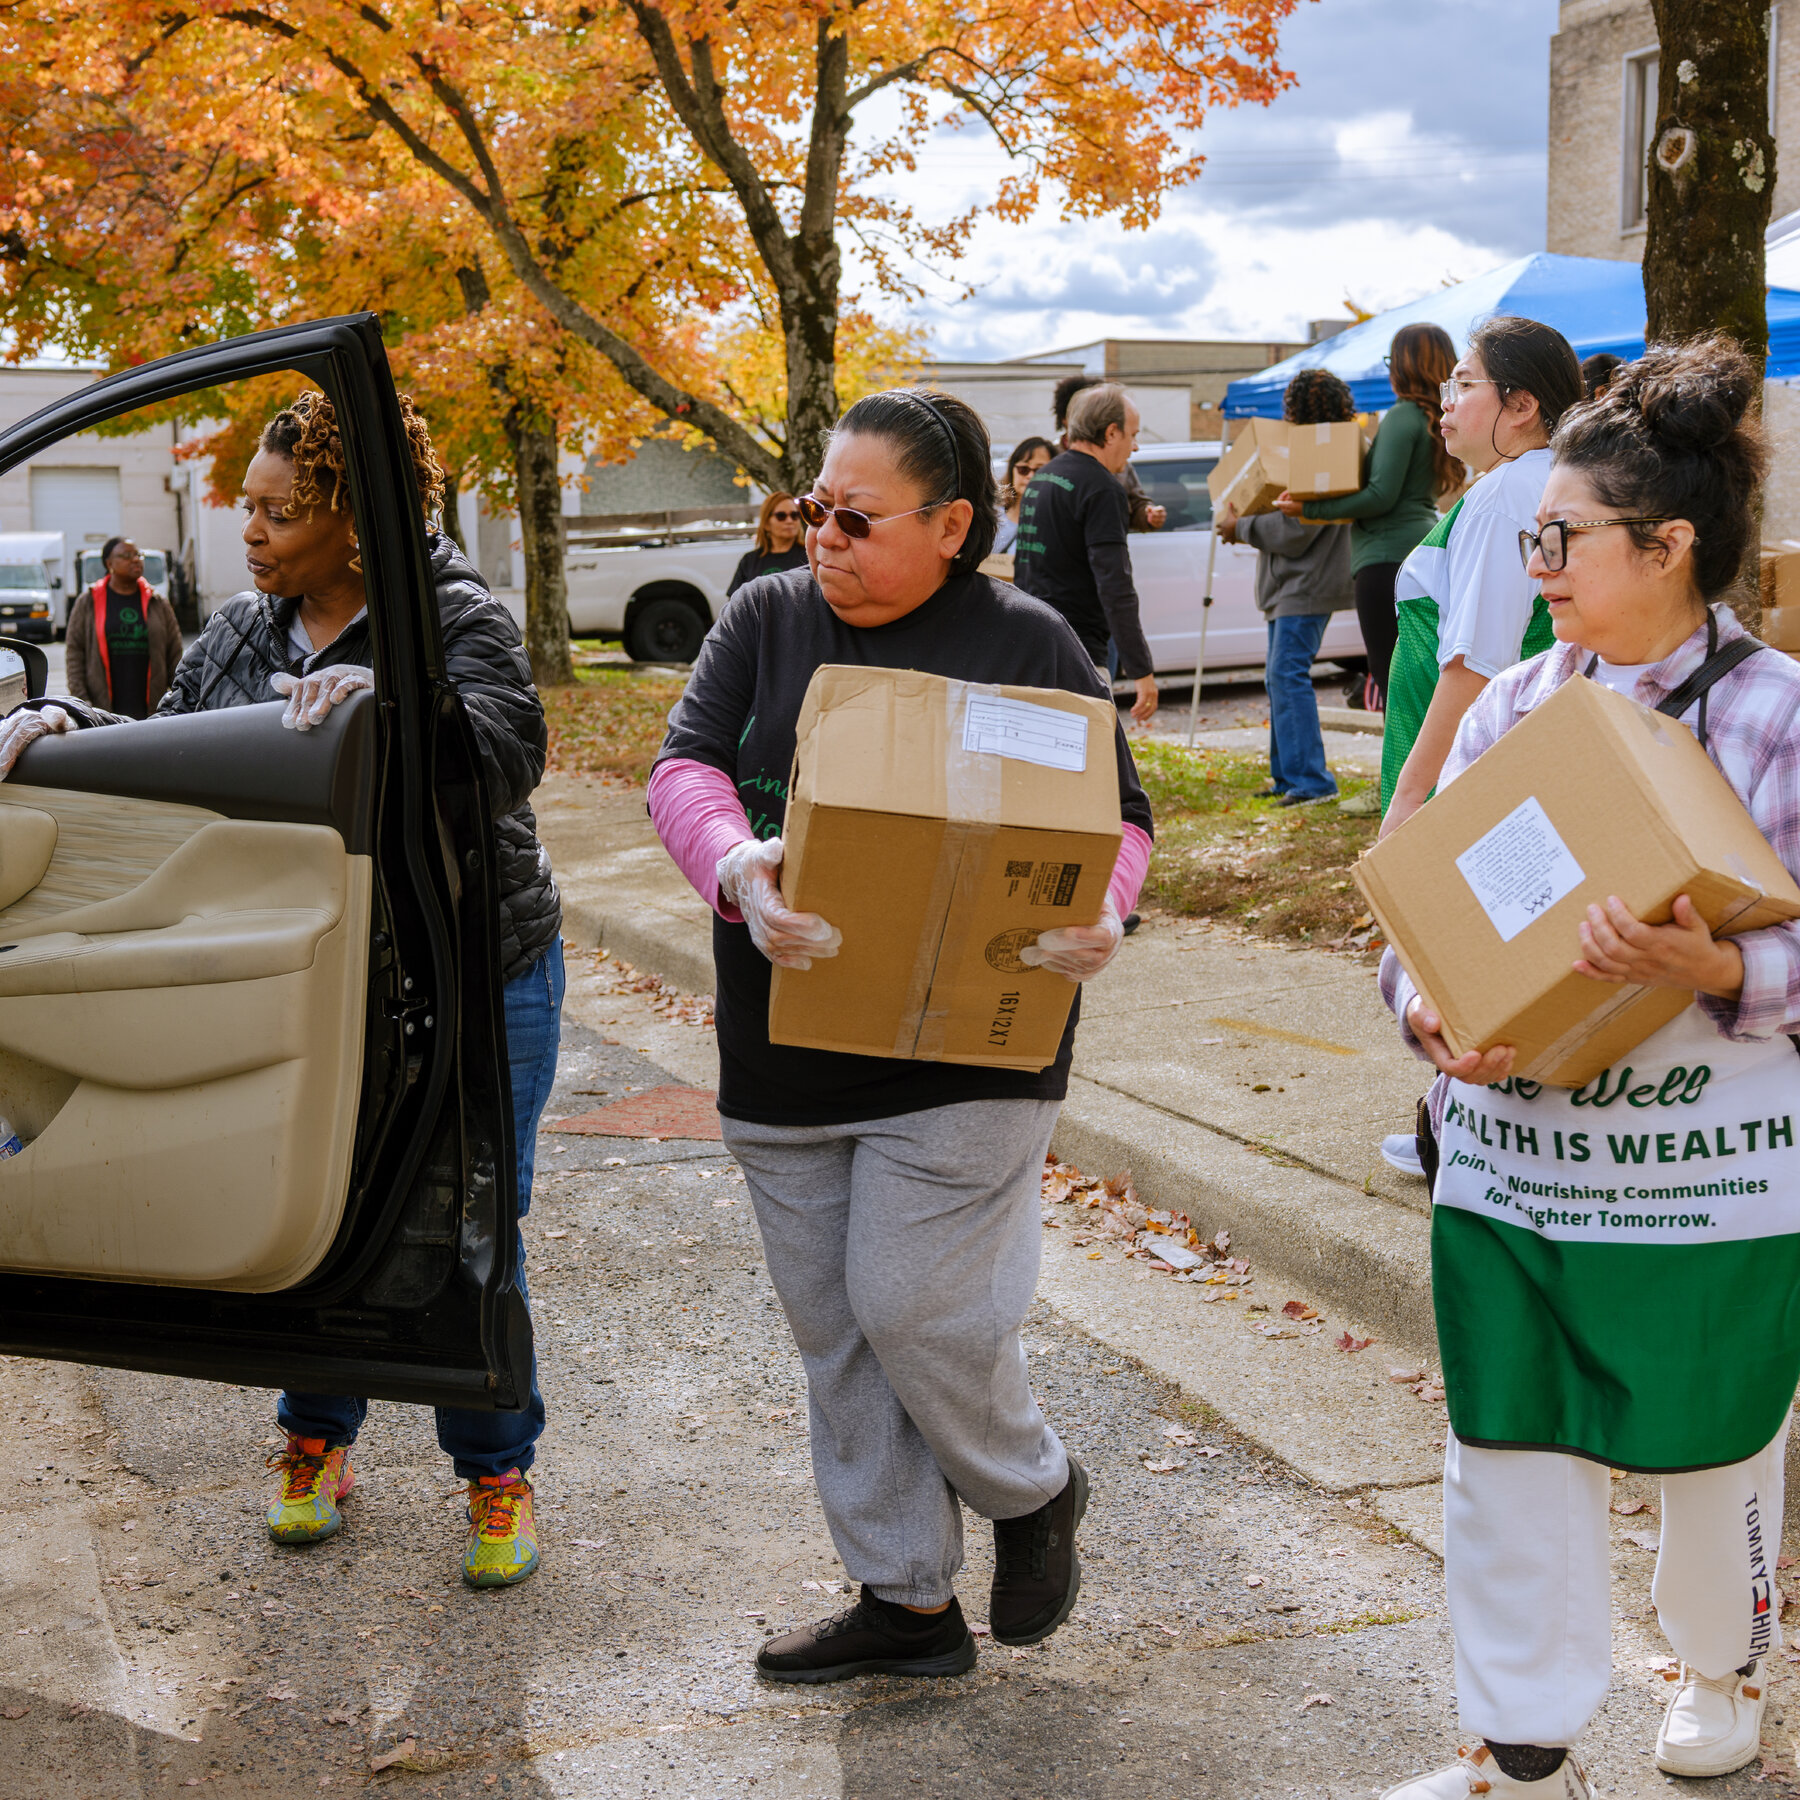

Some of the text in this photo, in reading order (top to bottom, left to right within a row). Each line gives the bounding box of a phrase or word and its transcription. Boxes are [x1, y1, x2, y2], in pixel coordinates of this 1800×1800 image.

[1570, 1065, 1712, 1108] Well
[1553, 1131, 1592, 1163] IS
[1607, 1114, 1794, 1165] WEALTH
[1447, 1150, 1769, 1204] Join Nourishing Communities
[1484, 1186, 1513, 1207] for
[1528, 1206, 1592, 1229] ighter
[1598, 1210, 1717, 1229] Tomorrow.
[1745, 1492, 1768, 1581] TOMMY
[1747, 1613, 1771, 1663] HILFI
